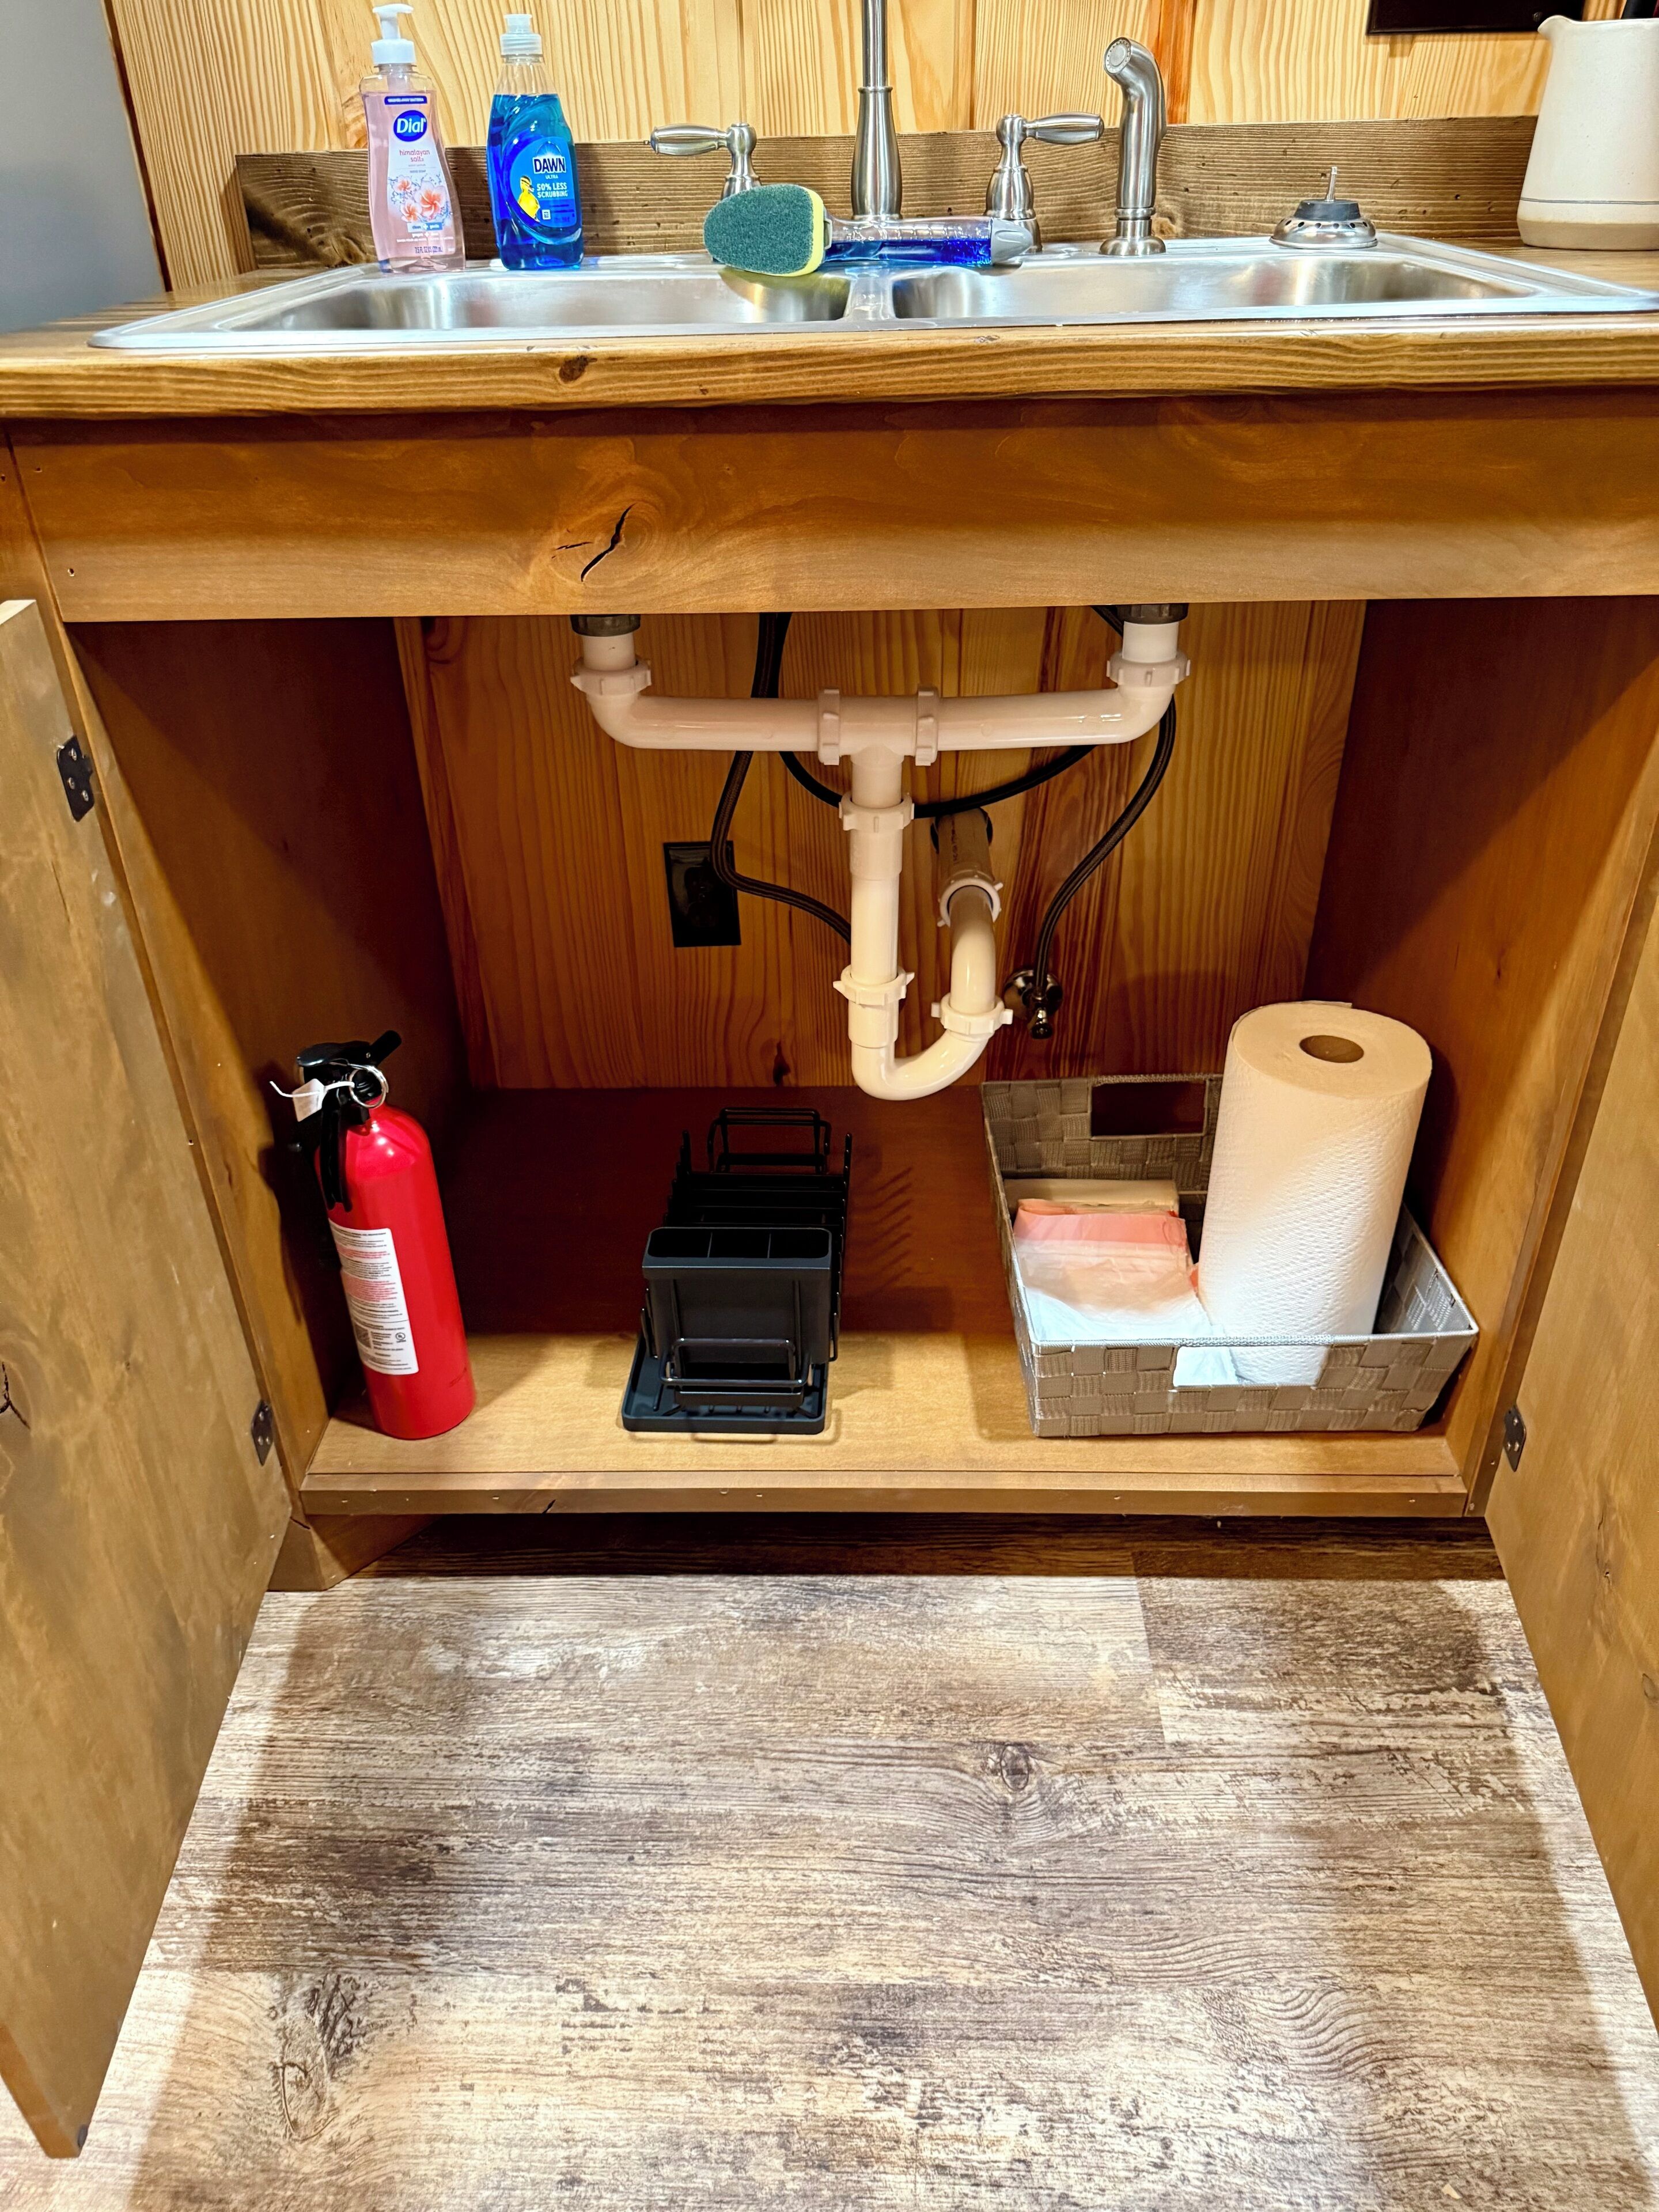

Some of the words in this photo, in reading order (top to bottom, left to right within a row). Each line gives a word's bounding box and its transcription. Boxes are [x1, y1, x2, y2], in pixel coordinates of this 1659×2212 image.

[396, 118, 425, 133] Dial
[533, 157, 566, 173] DAWN
[536, 183, 552, 191] 50%
[553, 182, 567, 190] LESS
[537, 190, 569, 198] SCRUBBING
